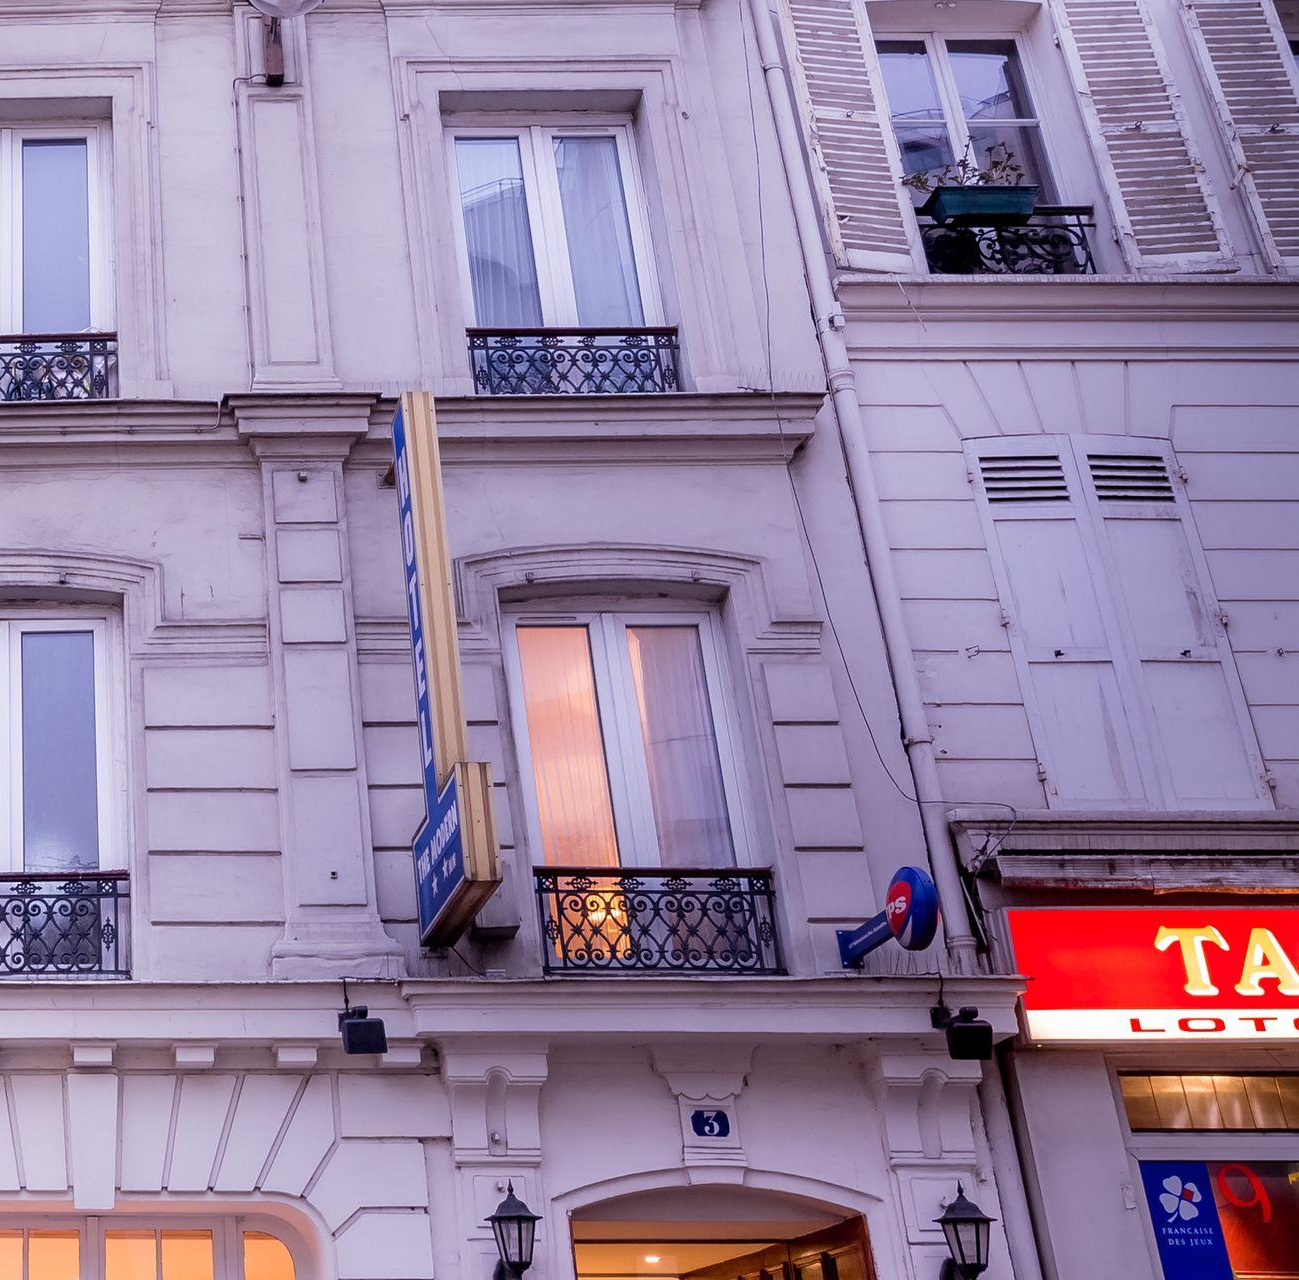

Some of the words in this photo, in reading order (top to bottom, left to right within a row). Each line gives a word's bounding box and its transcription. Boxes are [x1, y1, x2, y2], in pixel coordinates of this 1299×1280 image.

[397, 446, 433, 769] HOTEL
[418, 846, 431, 884] THE
[430, 800, 458, 866] MODERN
[1130, 1017, 1299, 1032] LOT
[703, 1111, 720, 1135] 3
[1168, 1238, 1186, 1246] DES
[1190, 1238, 1213, 1247] JEUX
